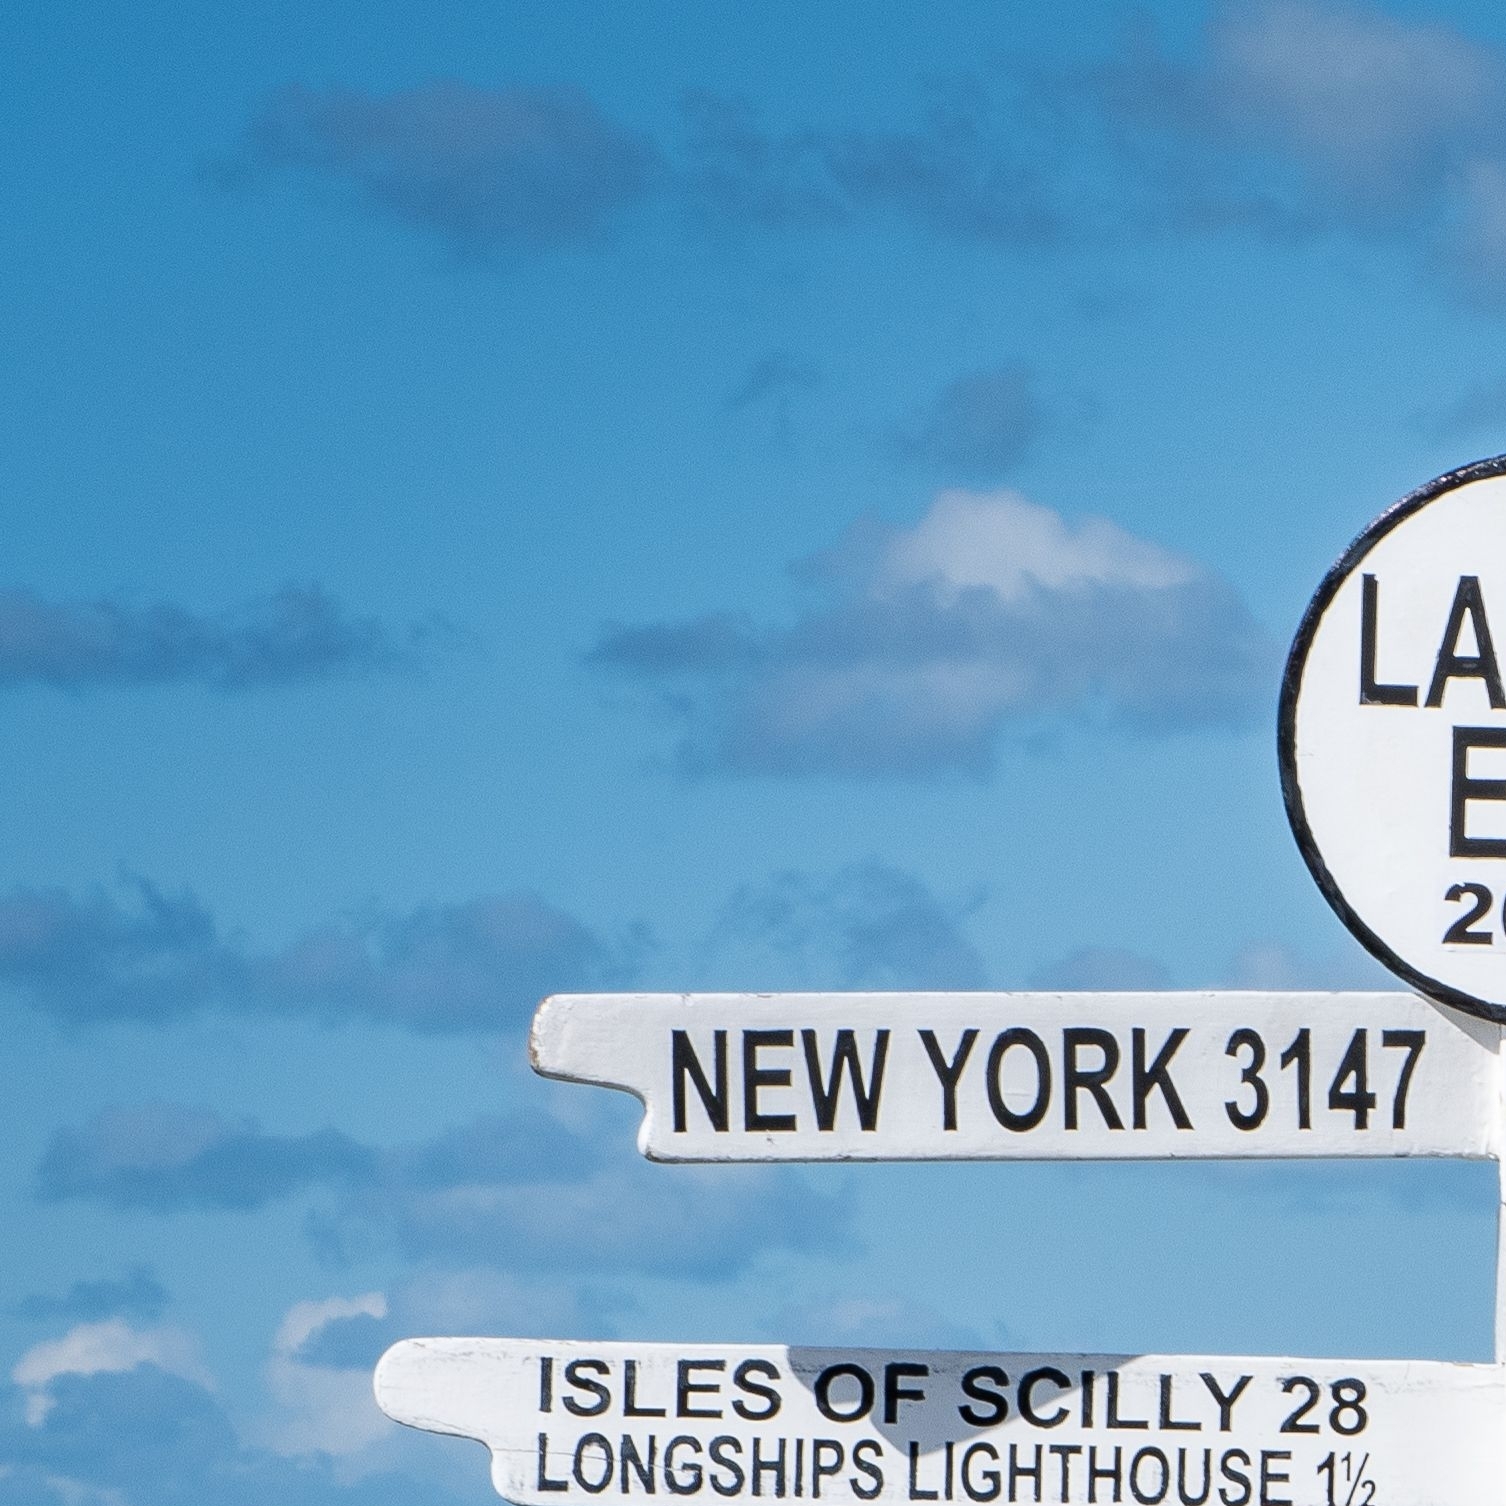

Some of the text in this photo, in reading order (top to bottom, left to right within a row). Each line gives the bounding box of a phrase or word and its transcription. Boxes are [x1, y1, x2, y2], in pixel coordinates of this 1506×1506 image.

[672, 1028, 1425, 1132] NEW YORK 3147
[540, 1358, 1366, 1435] ISLES OF SCILLY 28
[538, 1433, 883, 1499] LONGSHIPS
